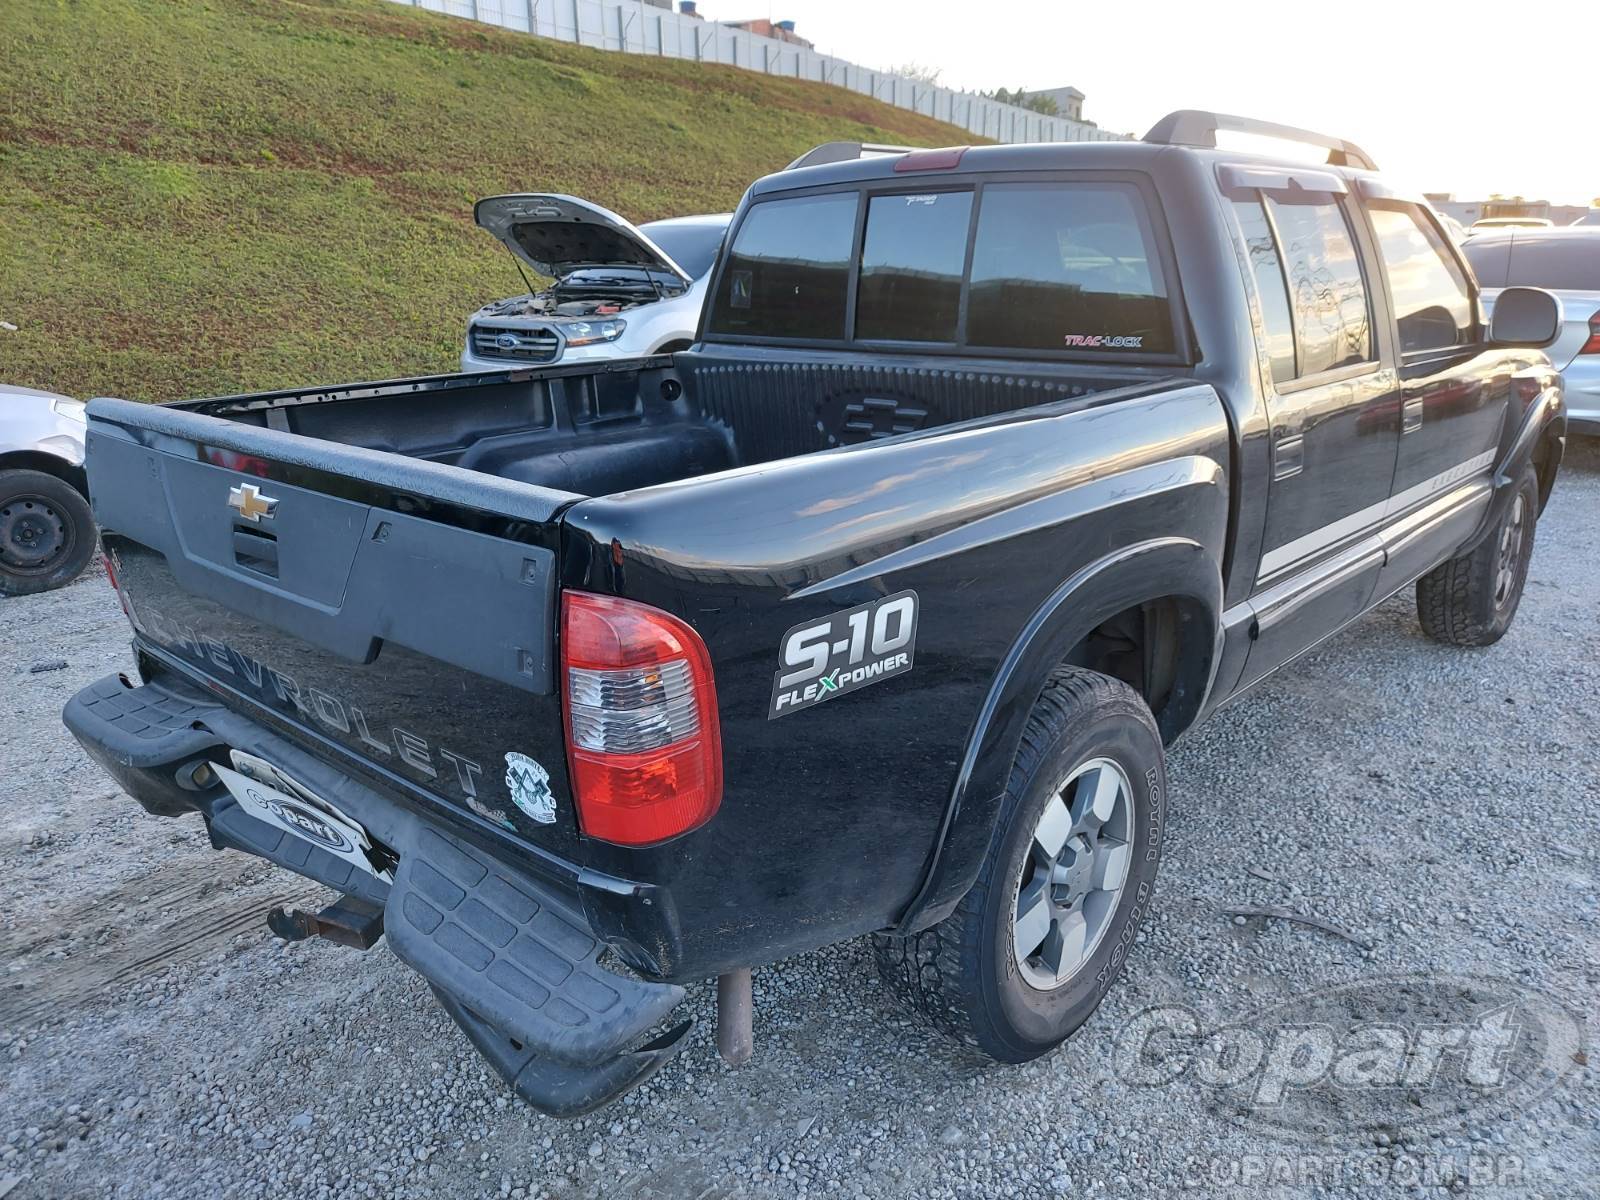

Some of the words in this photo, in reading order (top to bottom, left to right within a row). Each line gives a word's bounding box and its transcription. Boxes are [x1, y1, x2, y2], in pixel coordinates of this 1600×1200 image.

[1064, 334, 1142, 348] TRAC-LOCK
[779, 596, 914, 689] S-10
[246, 788, 339, 843] Copart
[1145, 766, 1161, 862] ROYAL
[1097, 881, 1149, 987] BLACK
